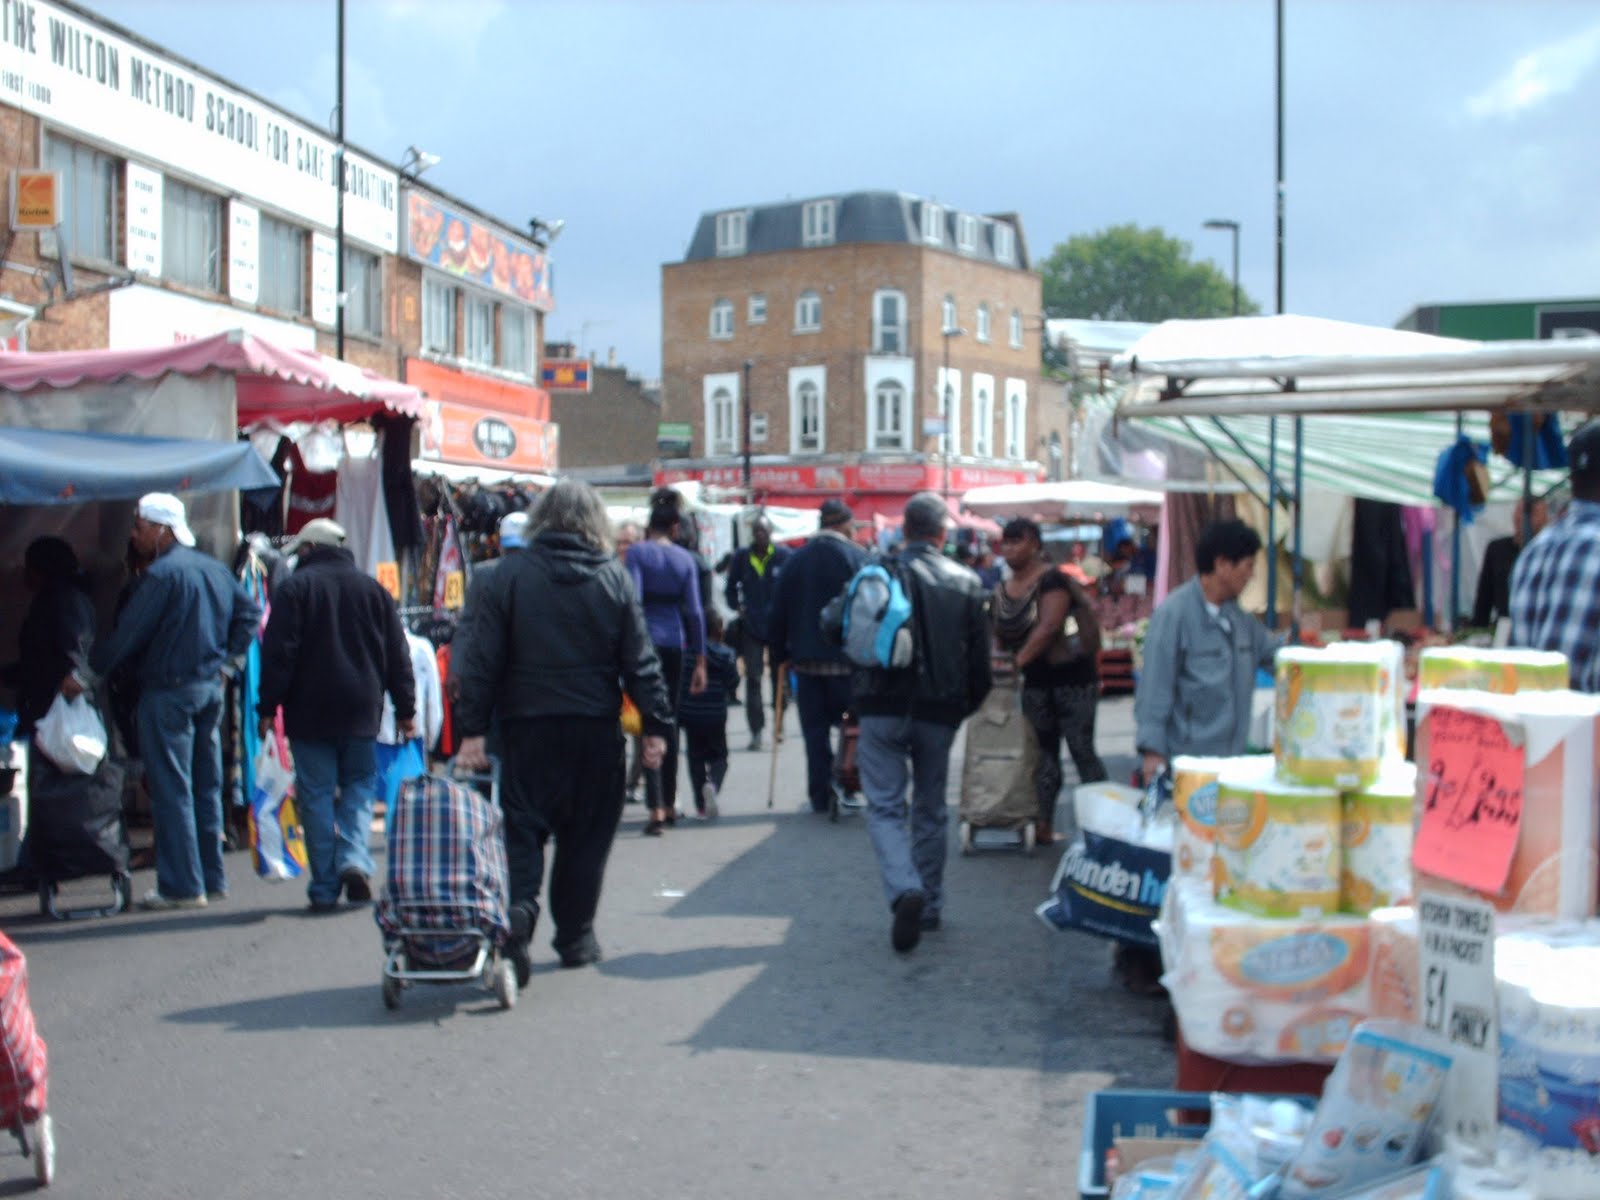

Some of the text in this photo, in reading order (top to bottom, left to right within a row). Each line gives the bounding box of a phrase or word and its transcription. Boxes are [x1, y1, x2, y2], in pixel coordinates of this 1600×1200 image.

[1, 0, 394, 211] THE WILTON METHOD SCHOOL FOR CAKE DCORATING
[2, 69, 51, 105] FIRST FLOOR
[18, 207, 50, 216] Kodak
[1451, 1006, 1491, 1049] ONLY
